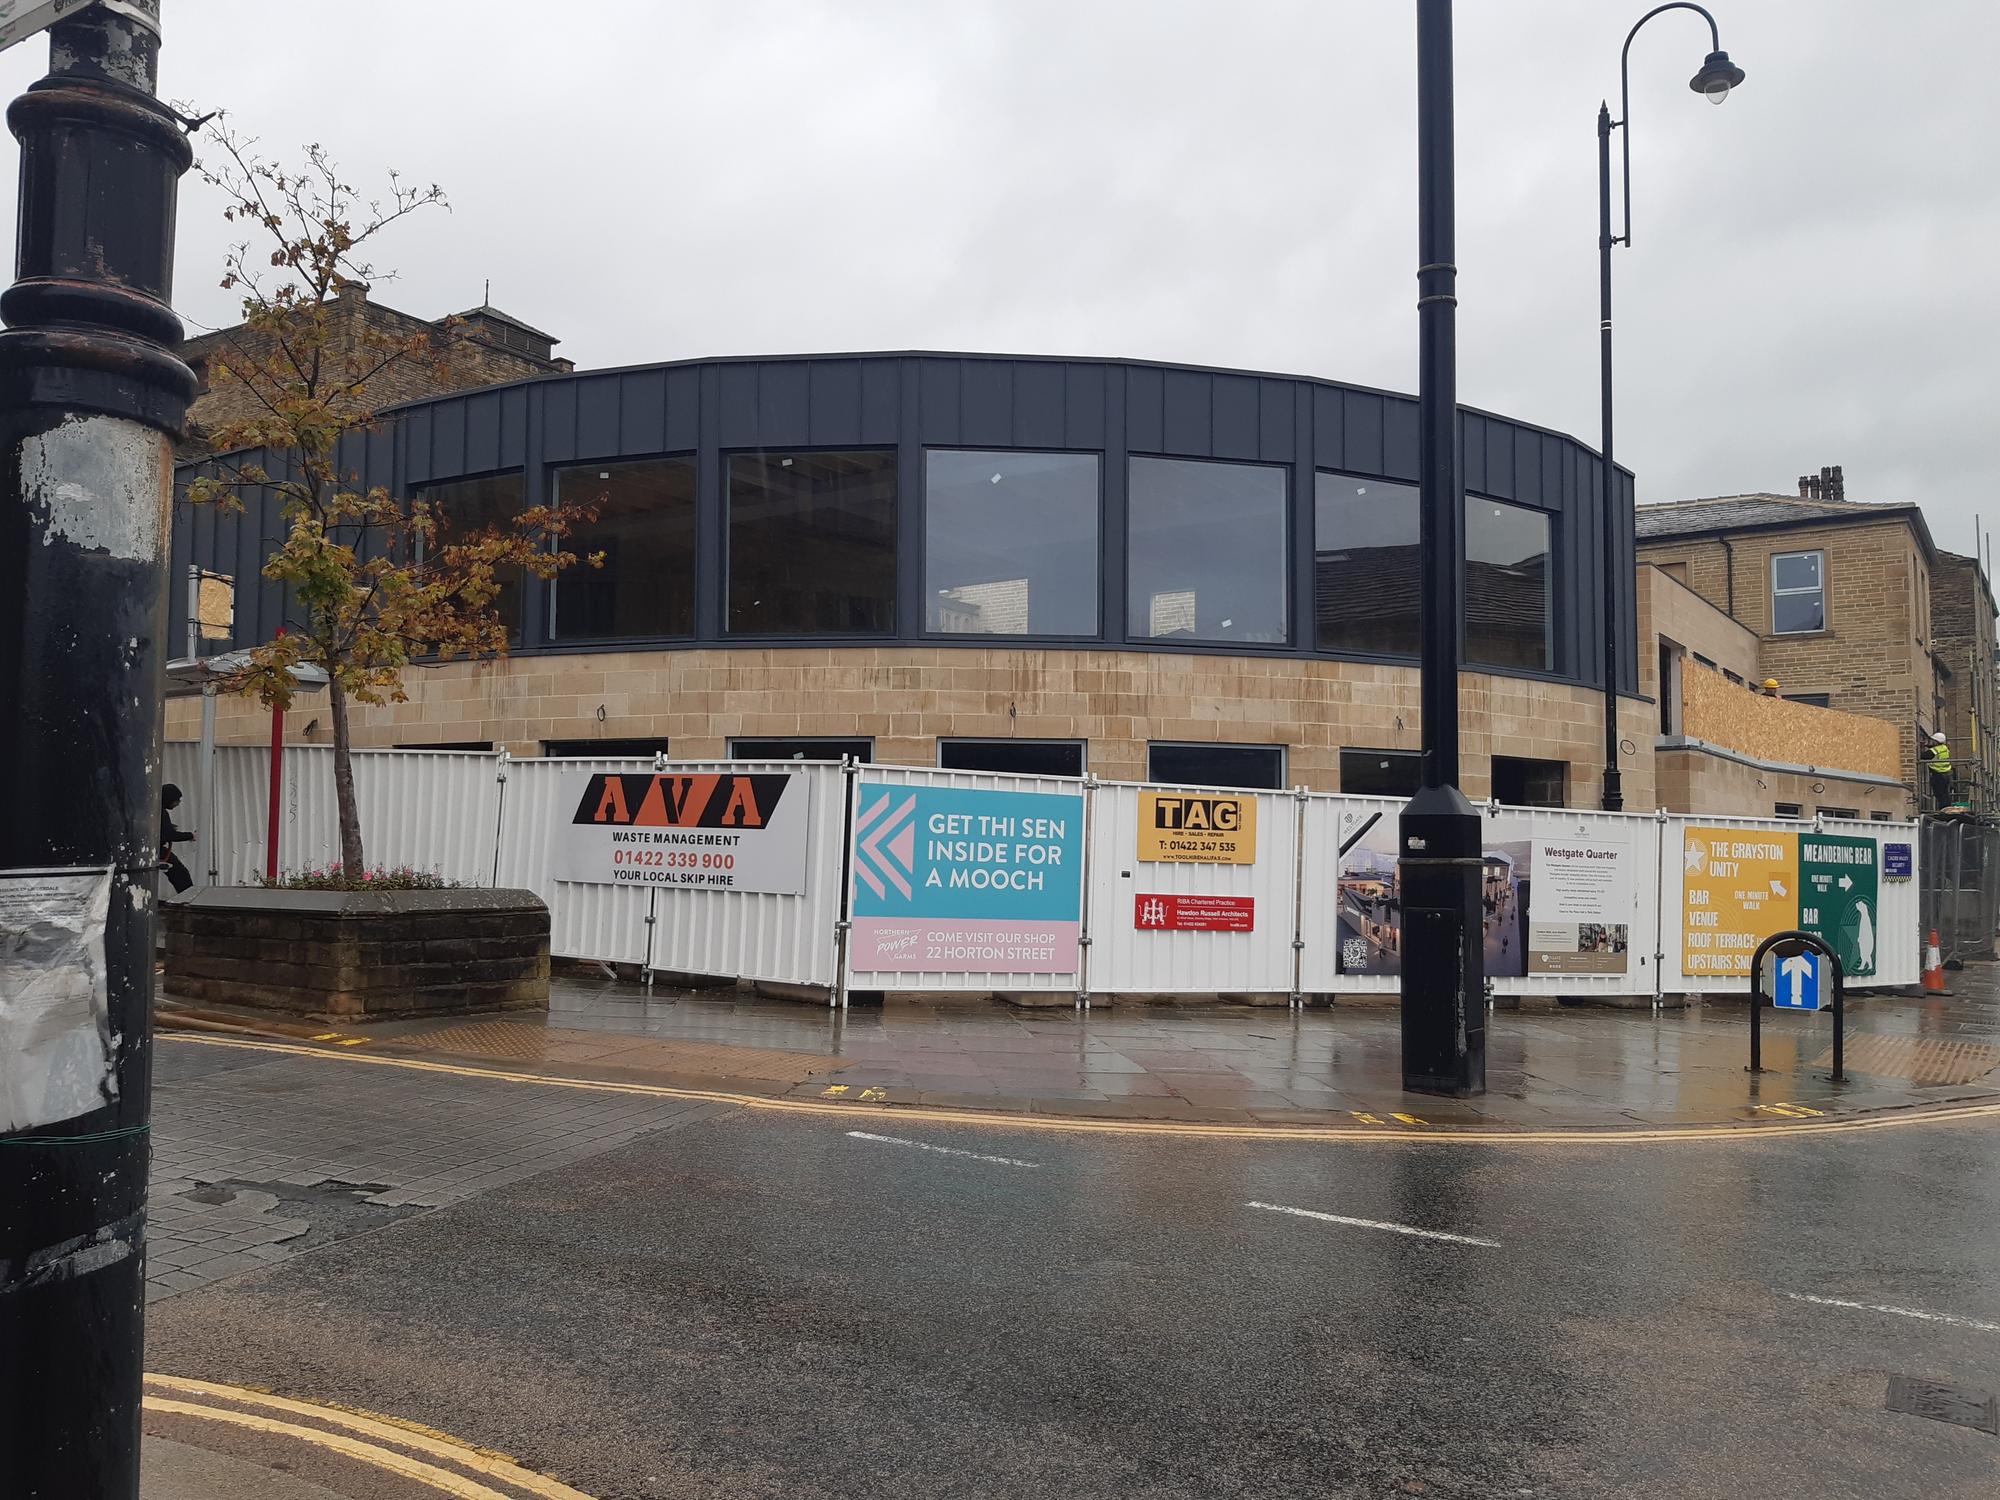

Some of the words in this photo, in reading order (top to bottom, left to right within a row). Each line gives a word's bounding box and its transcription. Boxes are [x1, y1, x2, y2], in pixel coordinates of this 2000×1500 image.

[594, 776, 761, 826] AVA
[1157, 800, 1237, 830] TAG
[928, 814, 973, 835] GET
[978, 816, 1015, 837] THI
[1021, 818, 1065, 840] SEN
[612, 831, 651, 843] WASTE
[653, 833, 740, 846] MANAGEMENT
[1159, 840, 1167, 850] T:
[1170, 841, 1198, 851] 01422
[1200, 841, 1216, 851] 347
[1219, 842, 1236, 852] 535
[928, 841, 1008, 863] INSIDE
[1015, 844, 1062, 865] FOR
[1545, 847, 1584, 860] Westgate
[1586, 849, 1618, 860] Quarter
[1711, 842, 1729, 857] THE
[1732, 843, 1783, 860] GRAYSTON
[1804, 844, 1853, 864] MEANDERING
[1855, 847, 1872, 865] BEAR
[614, 850, 663, 866] 01422
[667, 852, 697, 868] 339
[702, 853, 734, 870] 900
[1709, 861, 1739, 877] UNITY
[613, 870, 641, 881] YOUR
[643, 871, 678, 883] LOCAL
[680, 873, 705, 884] SKIP
[707, 874, 734, 886] HIRE
[925, 868, 942, 888] A
[949, 868, 1044, 891] MOOCH
[1689, 890, 1709, 905] BAR
[1735, 890, 1745, 899] ONE
[1747, 891, 1769, 900] MINUTE
[1743, 901, 1760, 910] WALK
[1689, 912, 1718, 926] VENUE
[1803, 908, 1819, 924] BAR
[877, 935, 918, 956] POWER
[927, 931, 963, 943] COME
[965, 932, 993, 943] VISIT
[995, 933, 1021, 944] OUR
[1024, 933, 1055, 944] SHOP
[1688, 933, 1711, 948] ROOF
[1715, 933, 1755, 948] TERRACE
[926, 947, 941, 959] 22
[944, 947, 1004, 960] HORTON
[1007, 948, 1055, 961] STREET
[1688, 954, 1732, 969] UPSTAIRS
[1735, 955, 1752, 970] SNU
